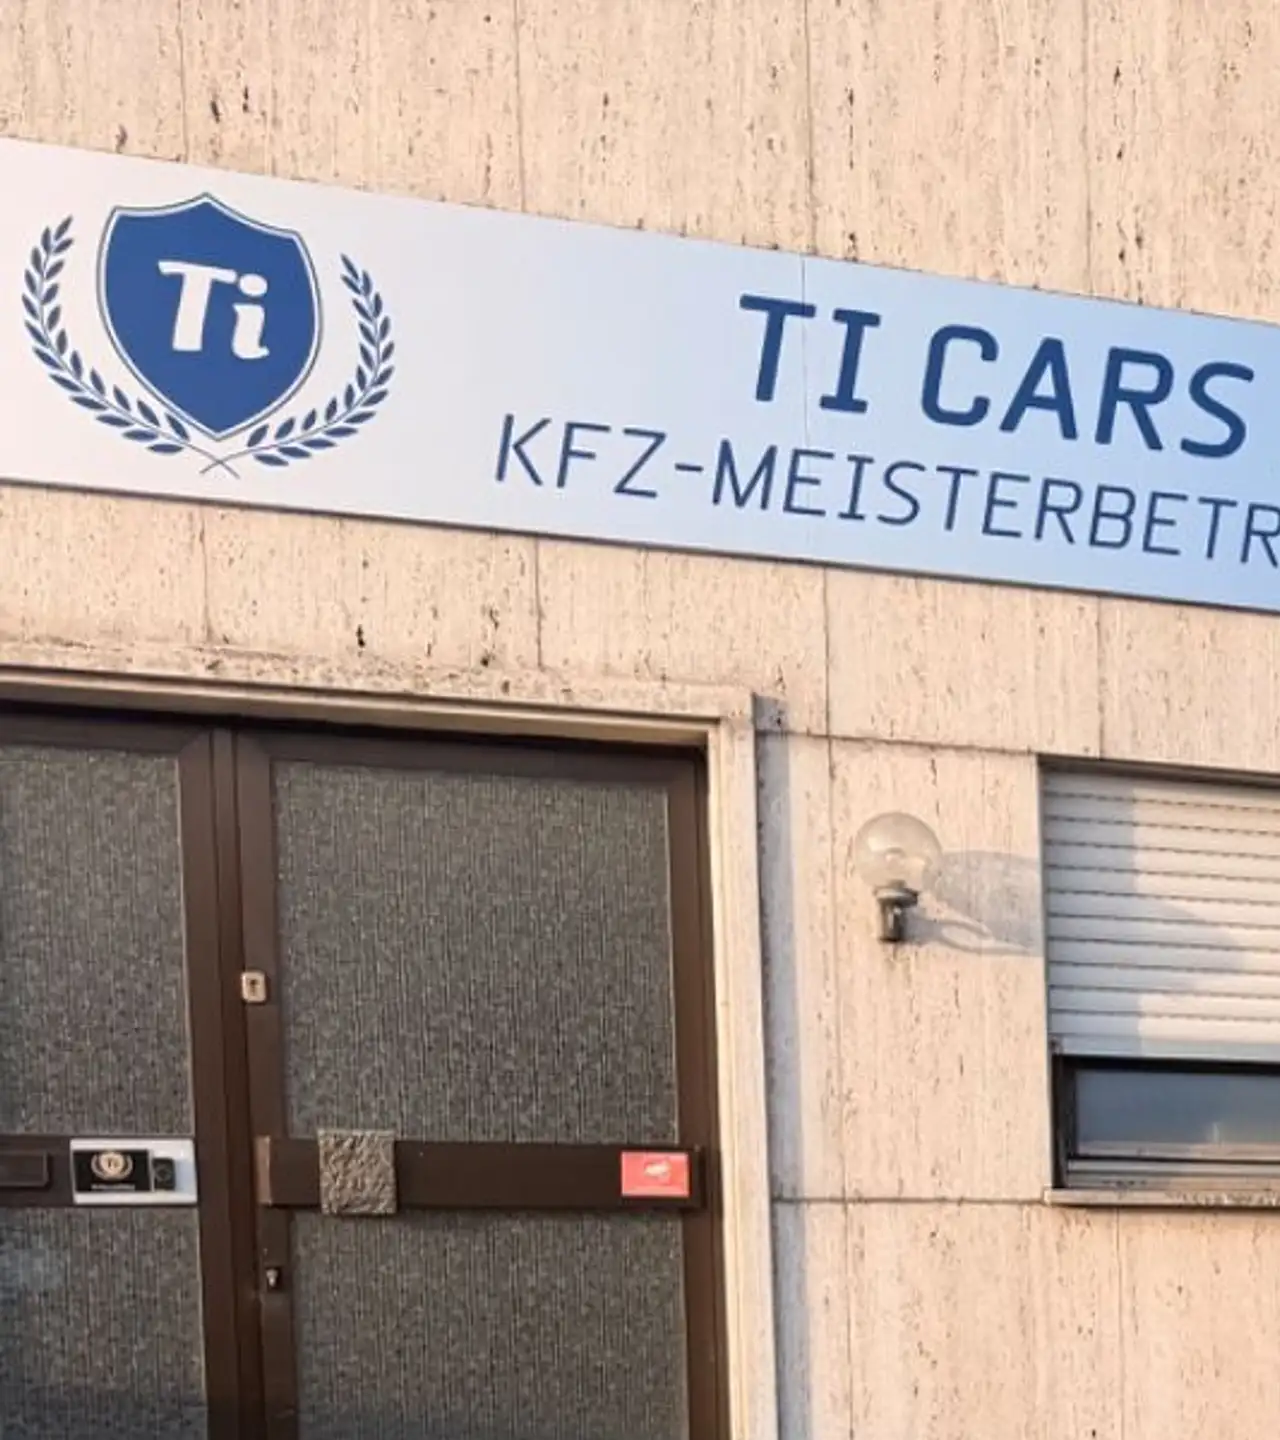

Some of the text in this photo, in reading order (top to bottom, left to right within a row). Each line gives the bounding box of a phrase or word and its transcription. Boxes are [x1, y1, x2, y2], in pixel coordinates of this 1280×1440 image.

[158, 259, 271, 360] Ti
[738, 293, 882, 415] TI
[920, 323, 1255, 460] CARS
